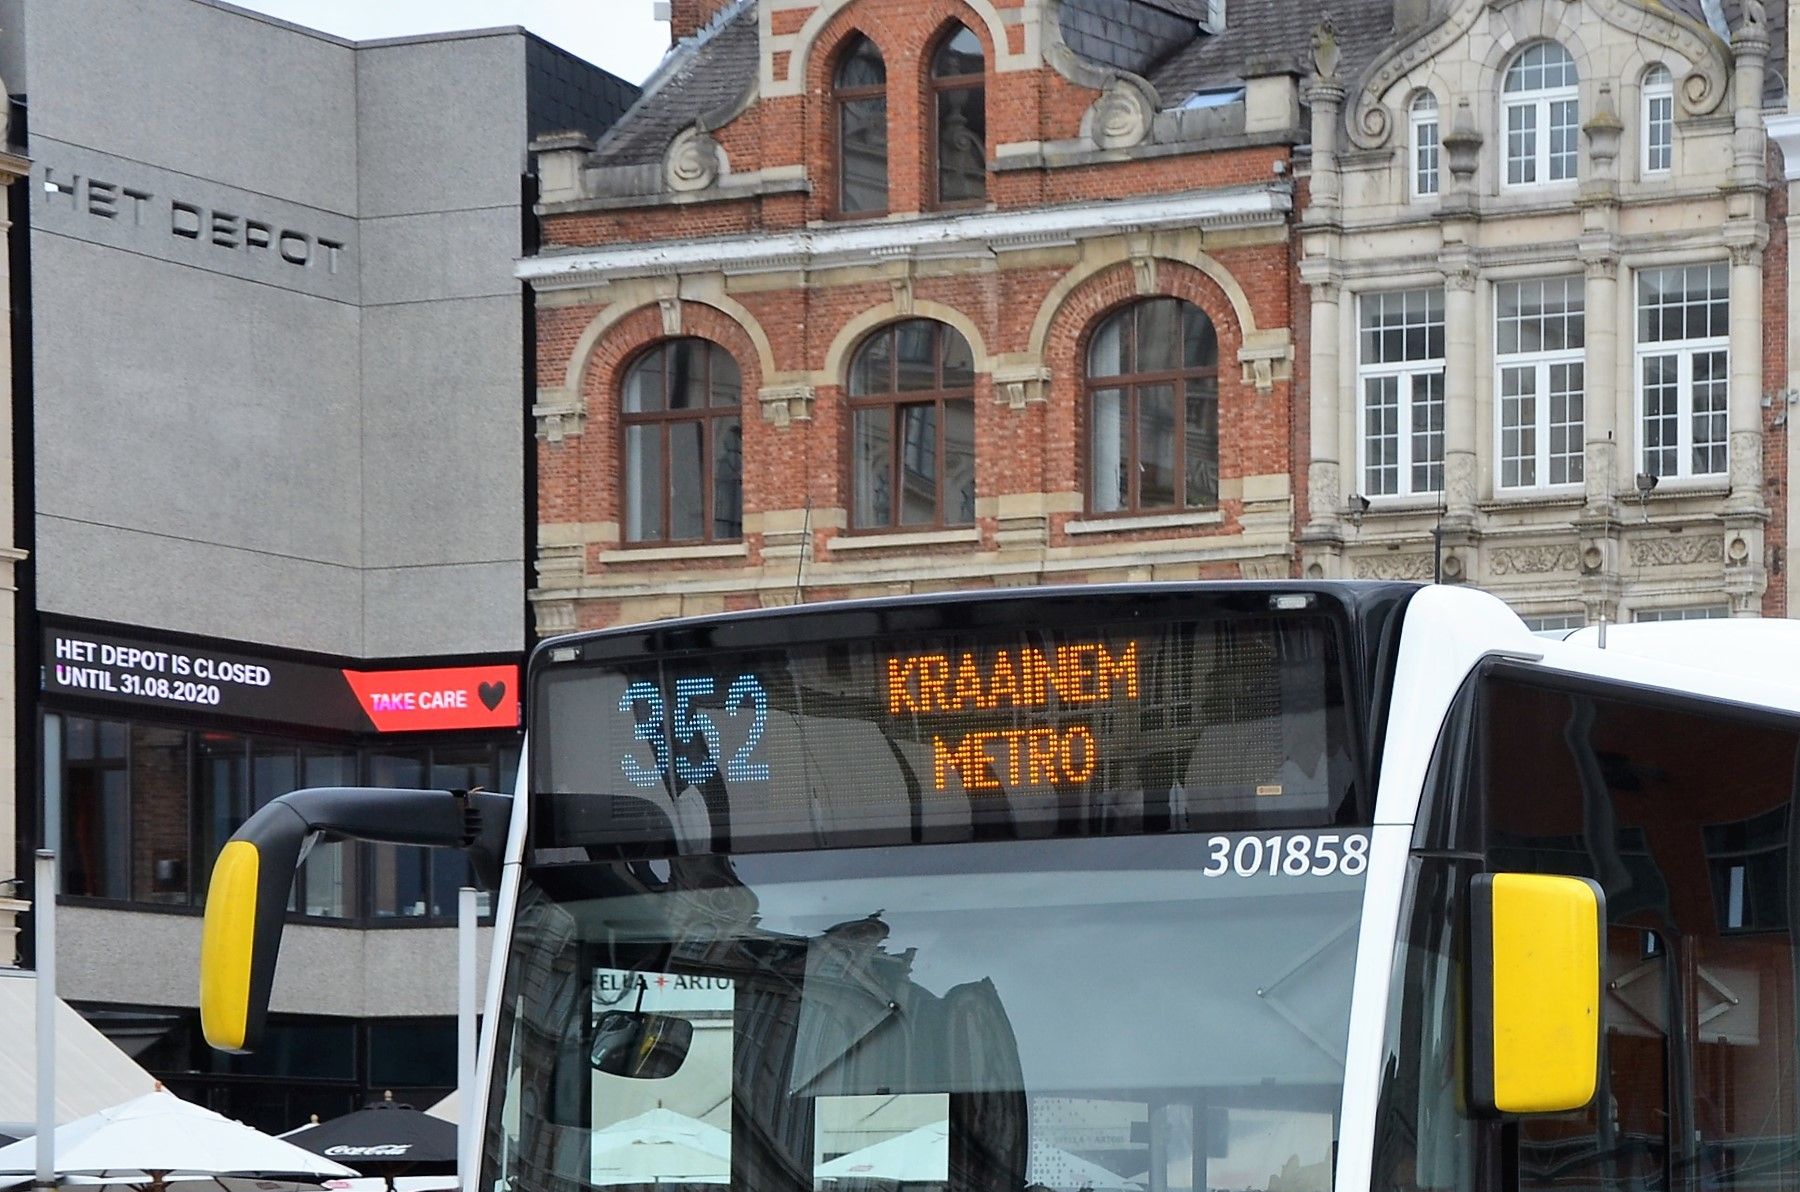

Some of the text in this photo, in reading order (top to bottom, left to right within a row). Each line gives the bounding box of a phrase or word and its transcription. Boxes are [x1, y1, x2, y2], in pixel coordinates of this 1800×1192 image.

[44, 168, 346, 275] HET DEPOT
[56, 638, 271, 686] HET DEPOT IS CLOSED
[56, 664, 220, 705] UNTIL 31.08.2020
[888, 640, 1139, 715] KRAAINEM
[370, 690, 468, 711] TAKE CARE
[619, 672, 770, 788] 352
[933, 725, 1097, 791] METRO
[1203, 834, 1368, 878] 301858
[598, 973, 733, 990] ELLA ARTO
[324, 1144, 413, 1156] Coca-Cola
